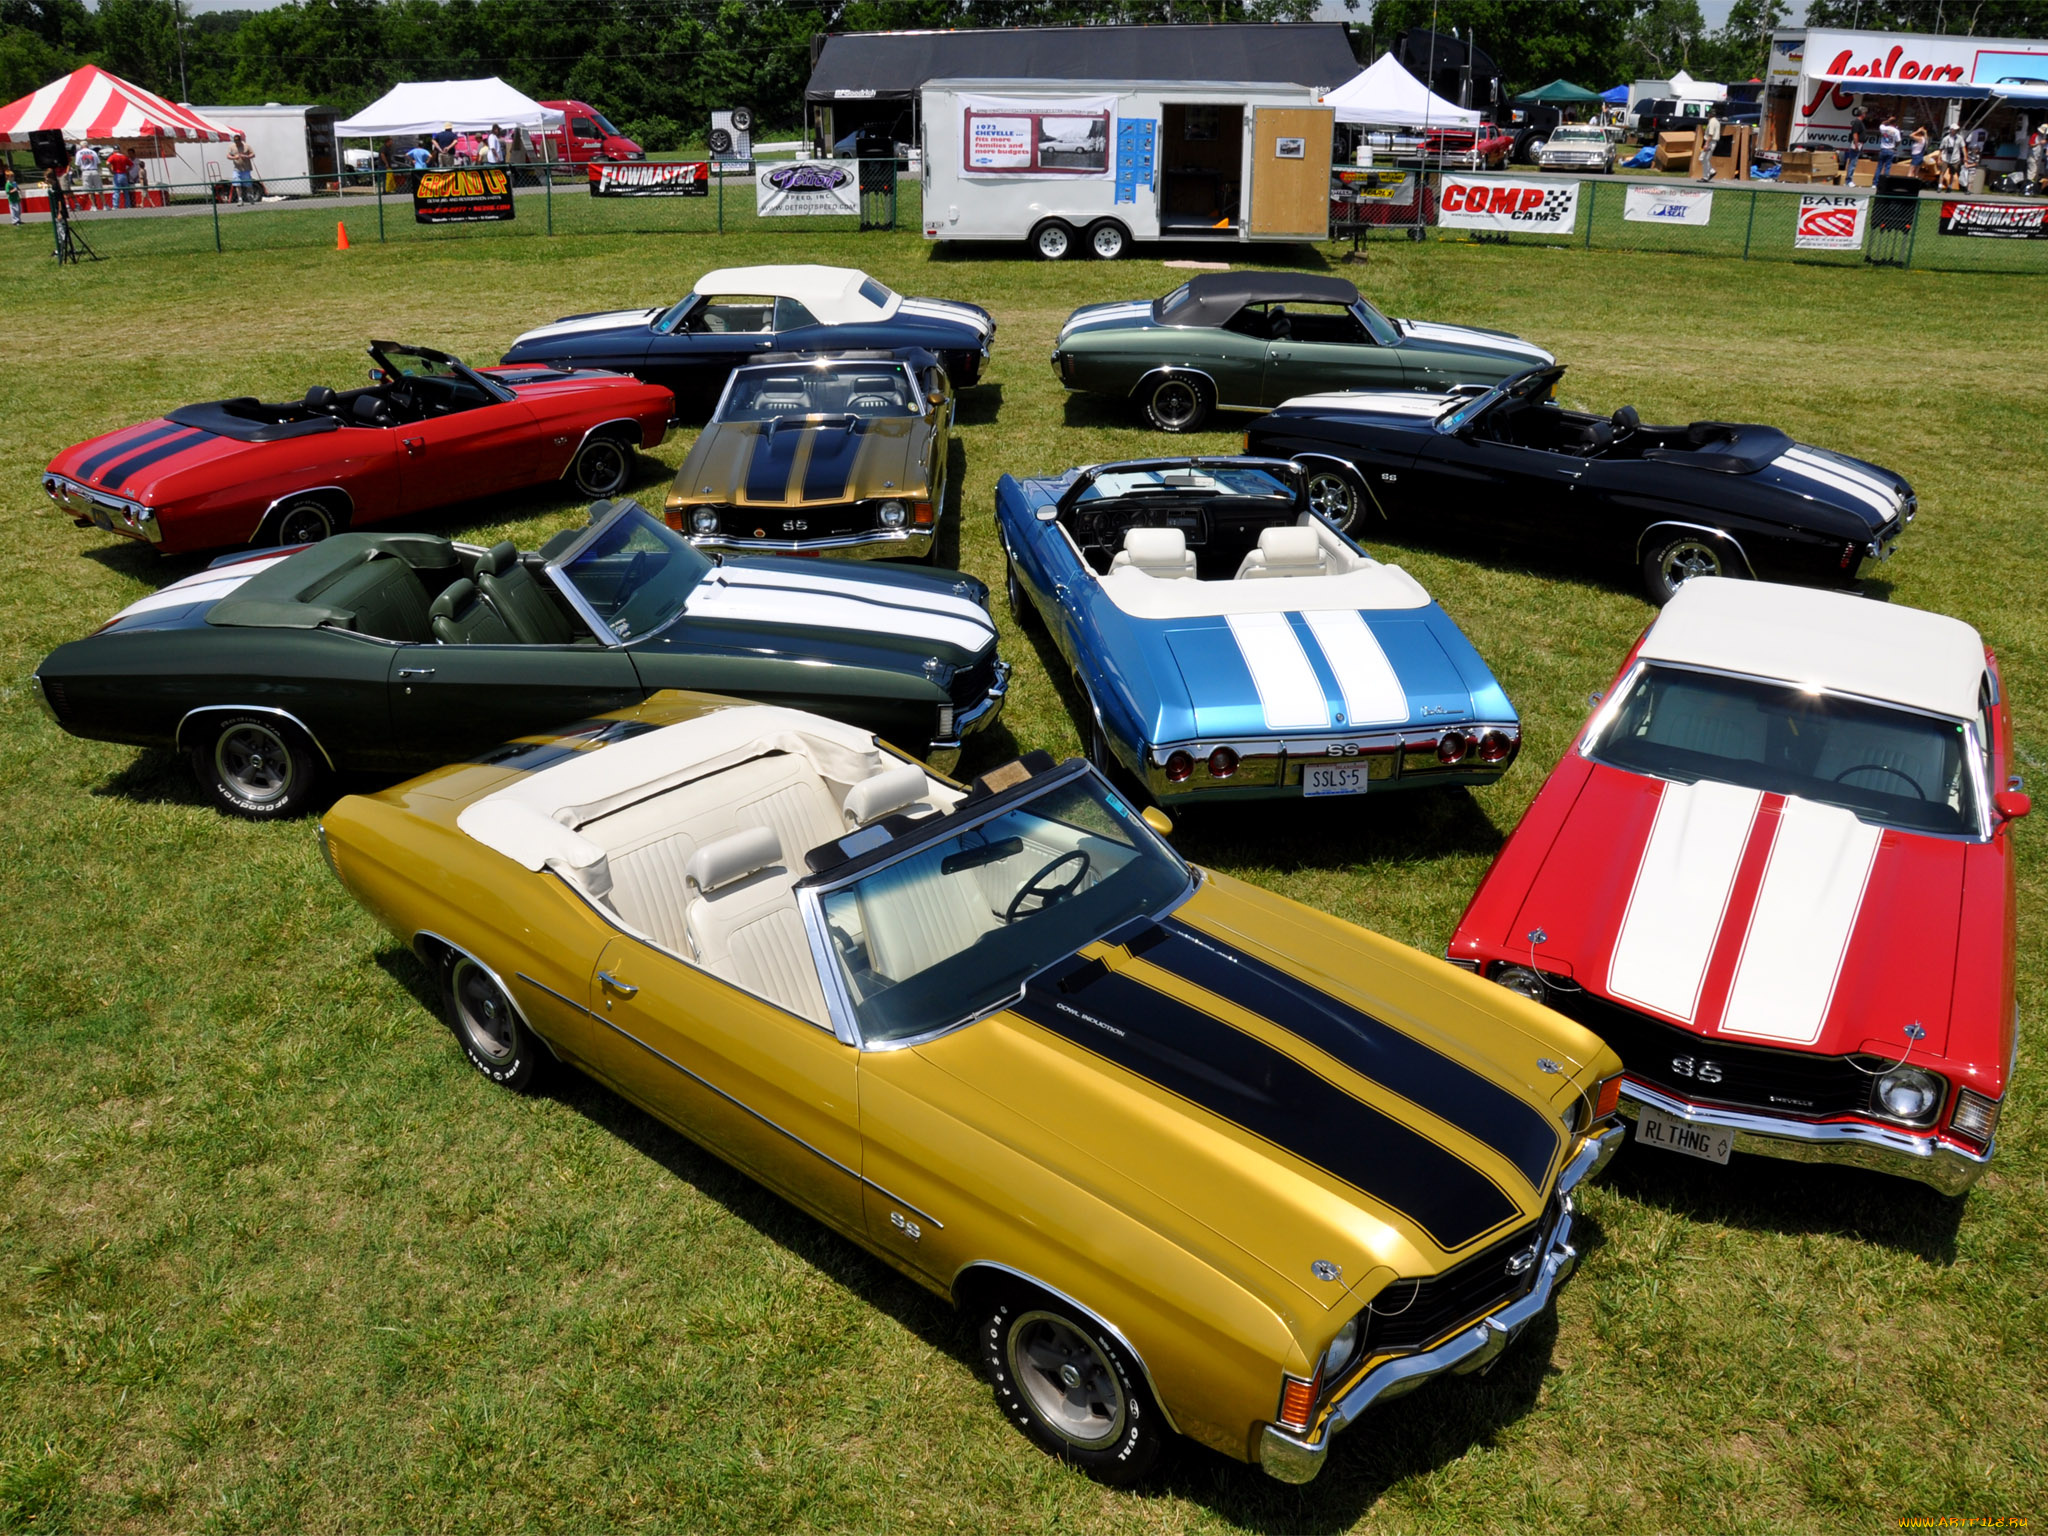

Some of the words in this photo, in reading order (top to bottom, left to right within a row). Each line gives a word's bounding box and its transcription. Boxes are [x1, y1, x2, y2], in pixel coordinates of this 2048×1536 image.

[417, 171, 485, 198] GROUND
[482, 169, 508, 194] UP
[599, 165, 696, 192] FLOWMASTER
[773, 168, 843, 190] Detroit
[1441, 184, 1544, 214] COMP
[1669, 188, 1677, 196] to
[1802, 196, 1856, 206] BAER
[1511, 210, 1561, 221] CAMS
[1947, 204, 2046, 230] FLOWMASTER
[1381, 473, 1397, 481] SS
[783, 520, 808, 531] SS
[1327, 743, 1360, 757] SS
[1056, 1002, 1080, 1017] COWL
[1081, 1013, 1126, 1037] INDUCTION
[1671, 1055, 1723, 1084] SS
[890, 1211, 921, 1238] SS
